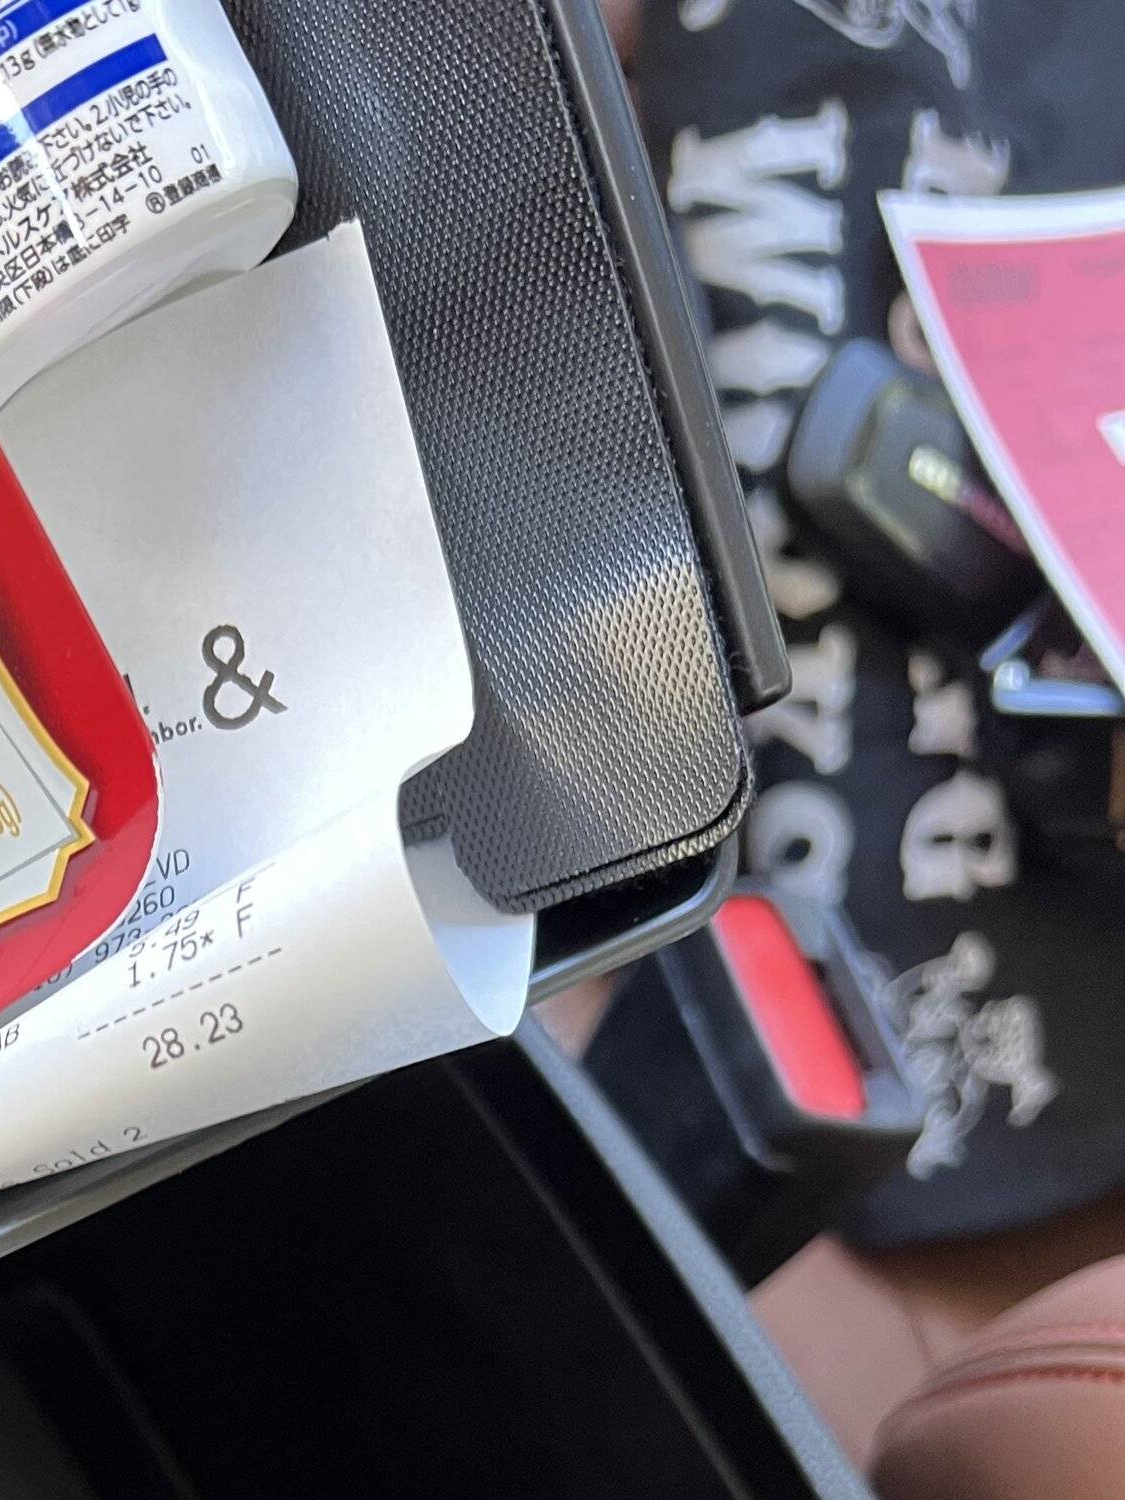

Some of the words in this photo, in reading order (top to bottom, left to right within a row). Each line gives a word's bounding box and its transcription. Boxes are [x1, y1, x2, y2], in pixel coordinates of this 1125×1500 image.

[190, 144, 210, 164] 01
[236, 902, 254, 939] F
[142, 1002, 244, 1070] 28.23
[32, 1140, 111, 1176] Sold
